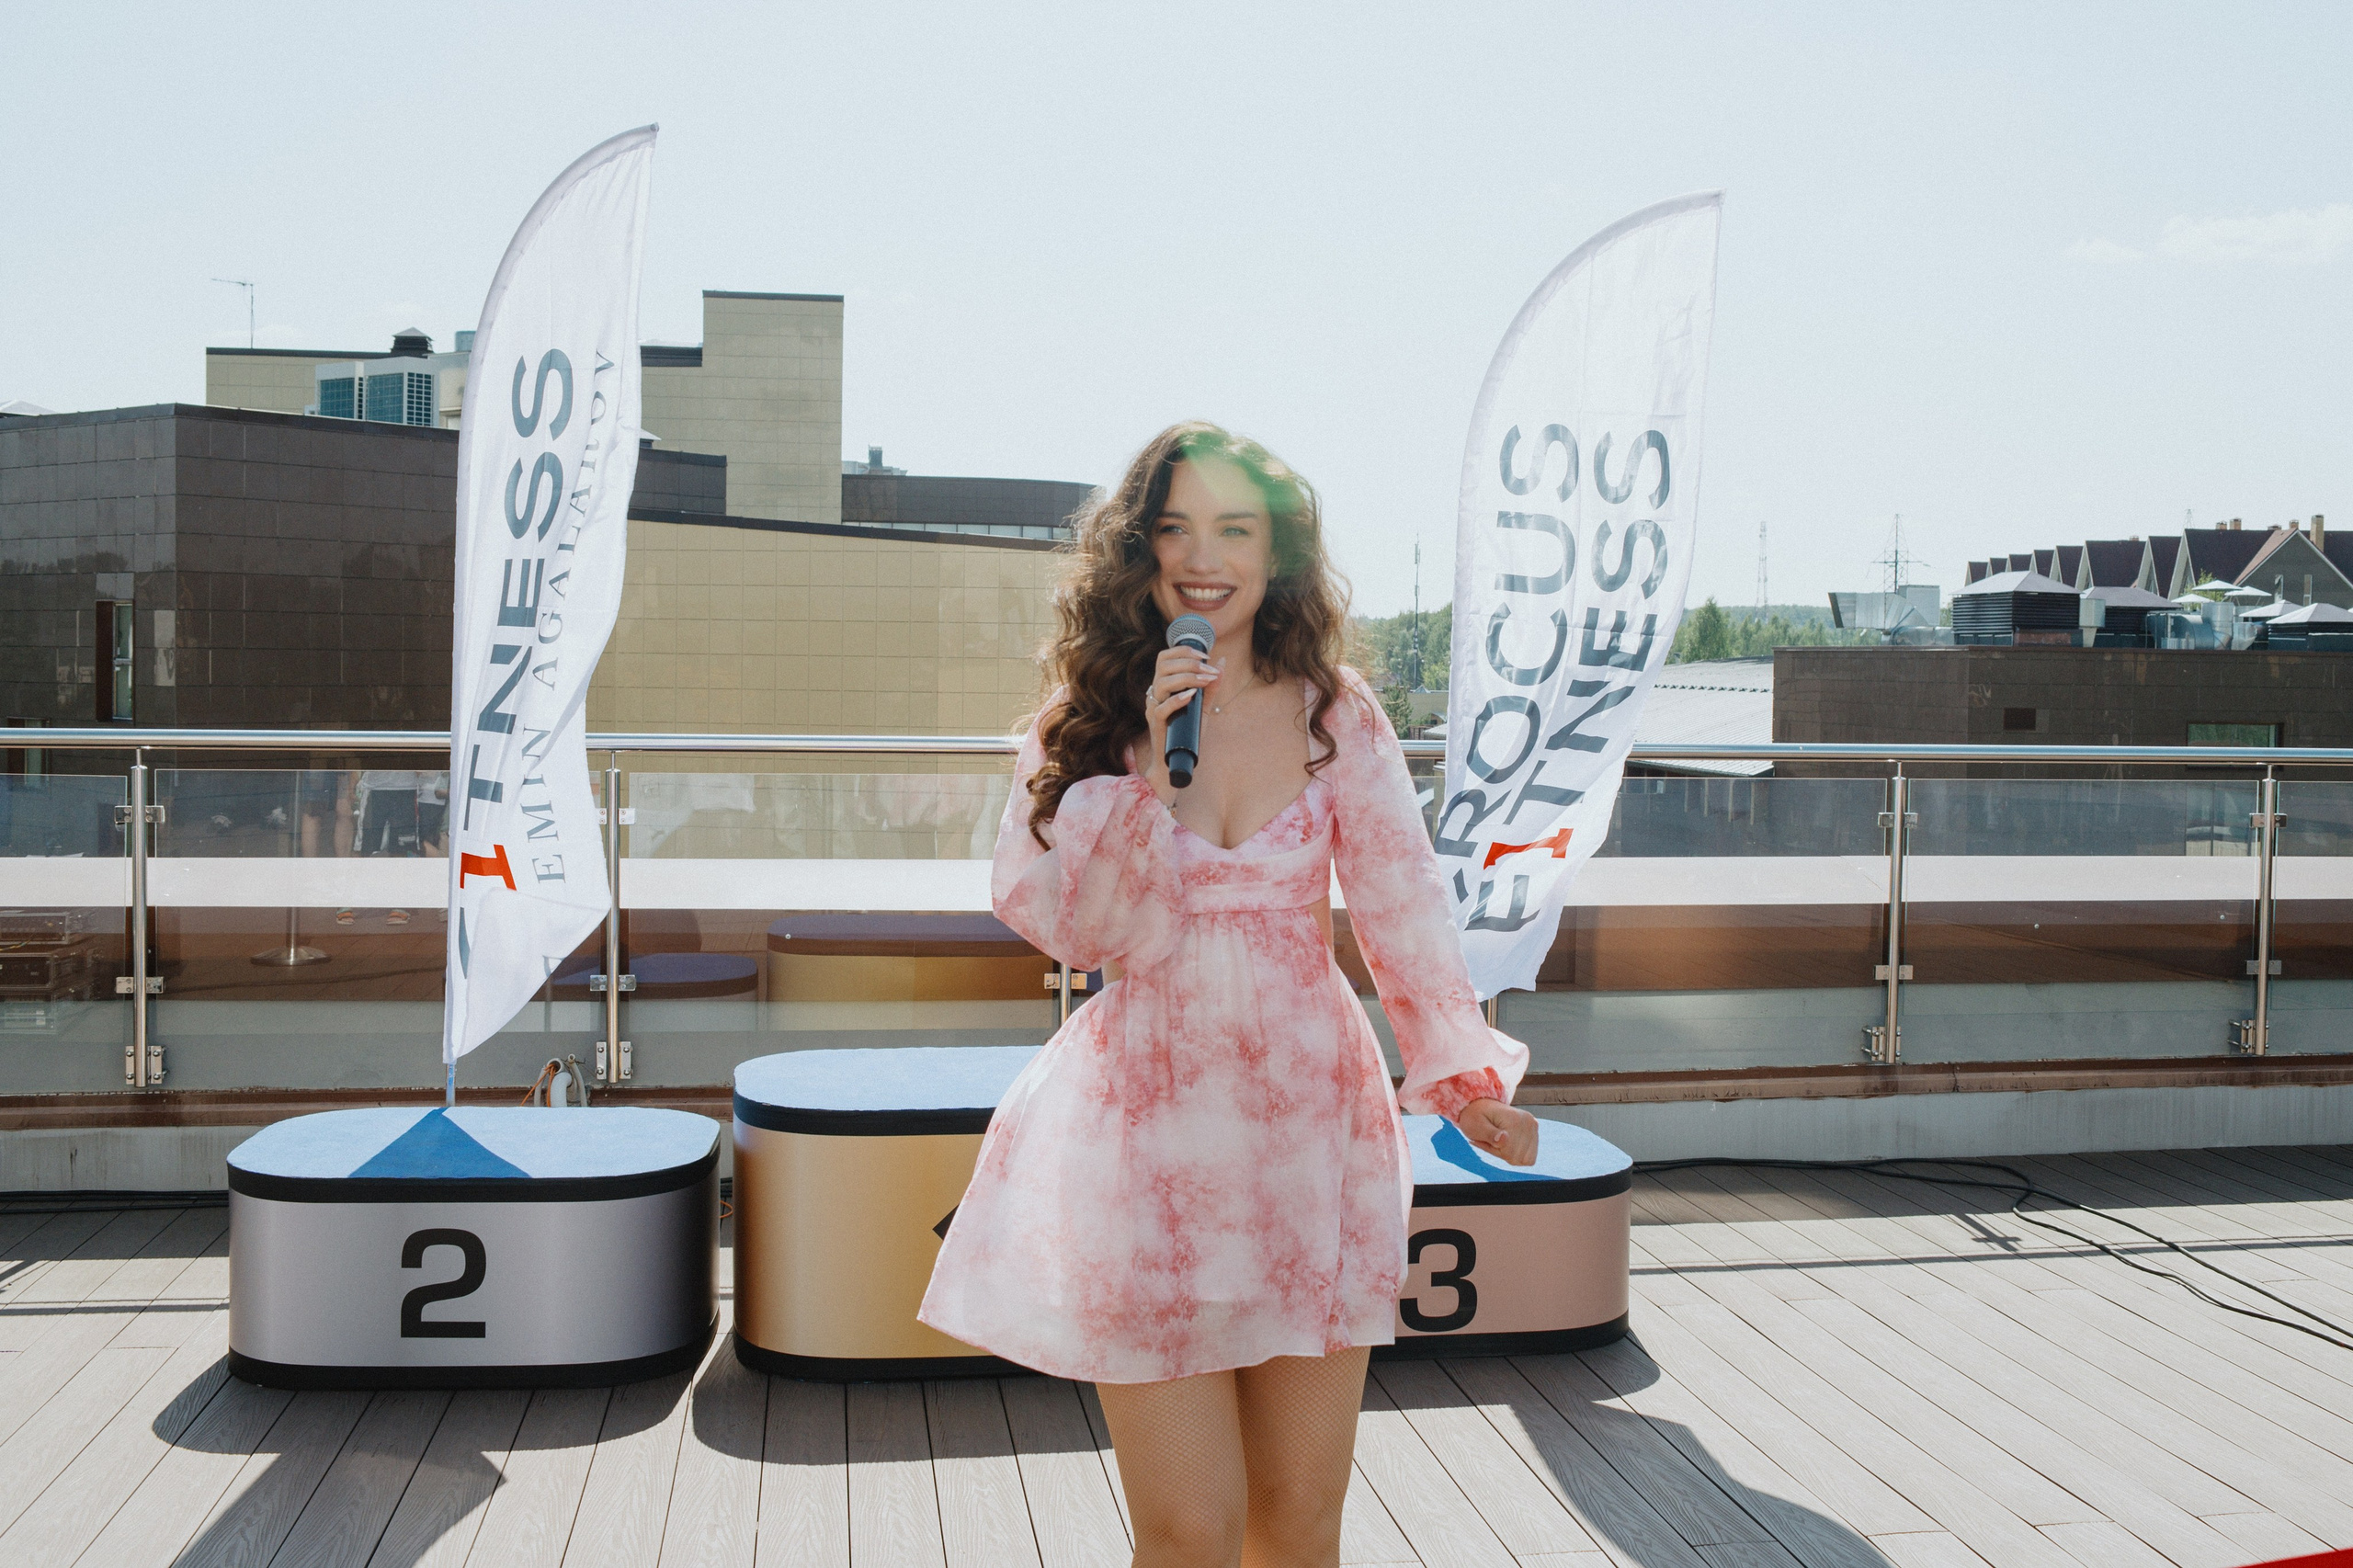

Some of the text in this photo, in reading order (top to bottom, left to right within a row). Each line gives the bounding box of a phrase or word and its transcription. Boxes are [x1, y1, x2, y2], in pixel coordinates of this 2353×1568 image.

[521, 724, 566, 884] EMIN
[400, 1228, 487, 1339] 2
[1399, 1228, 1478, 1334] 3
